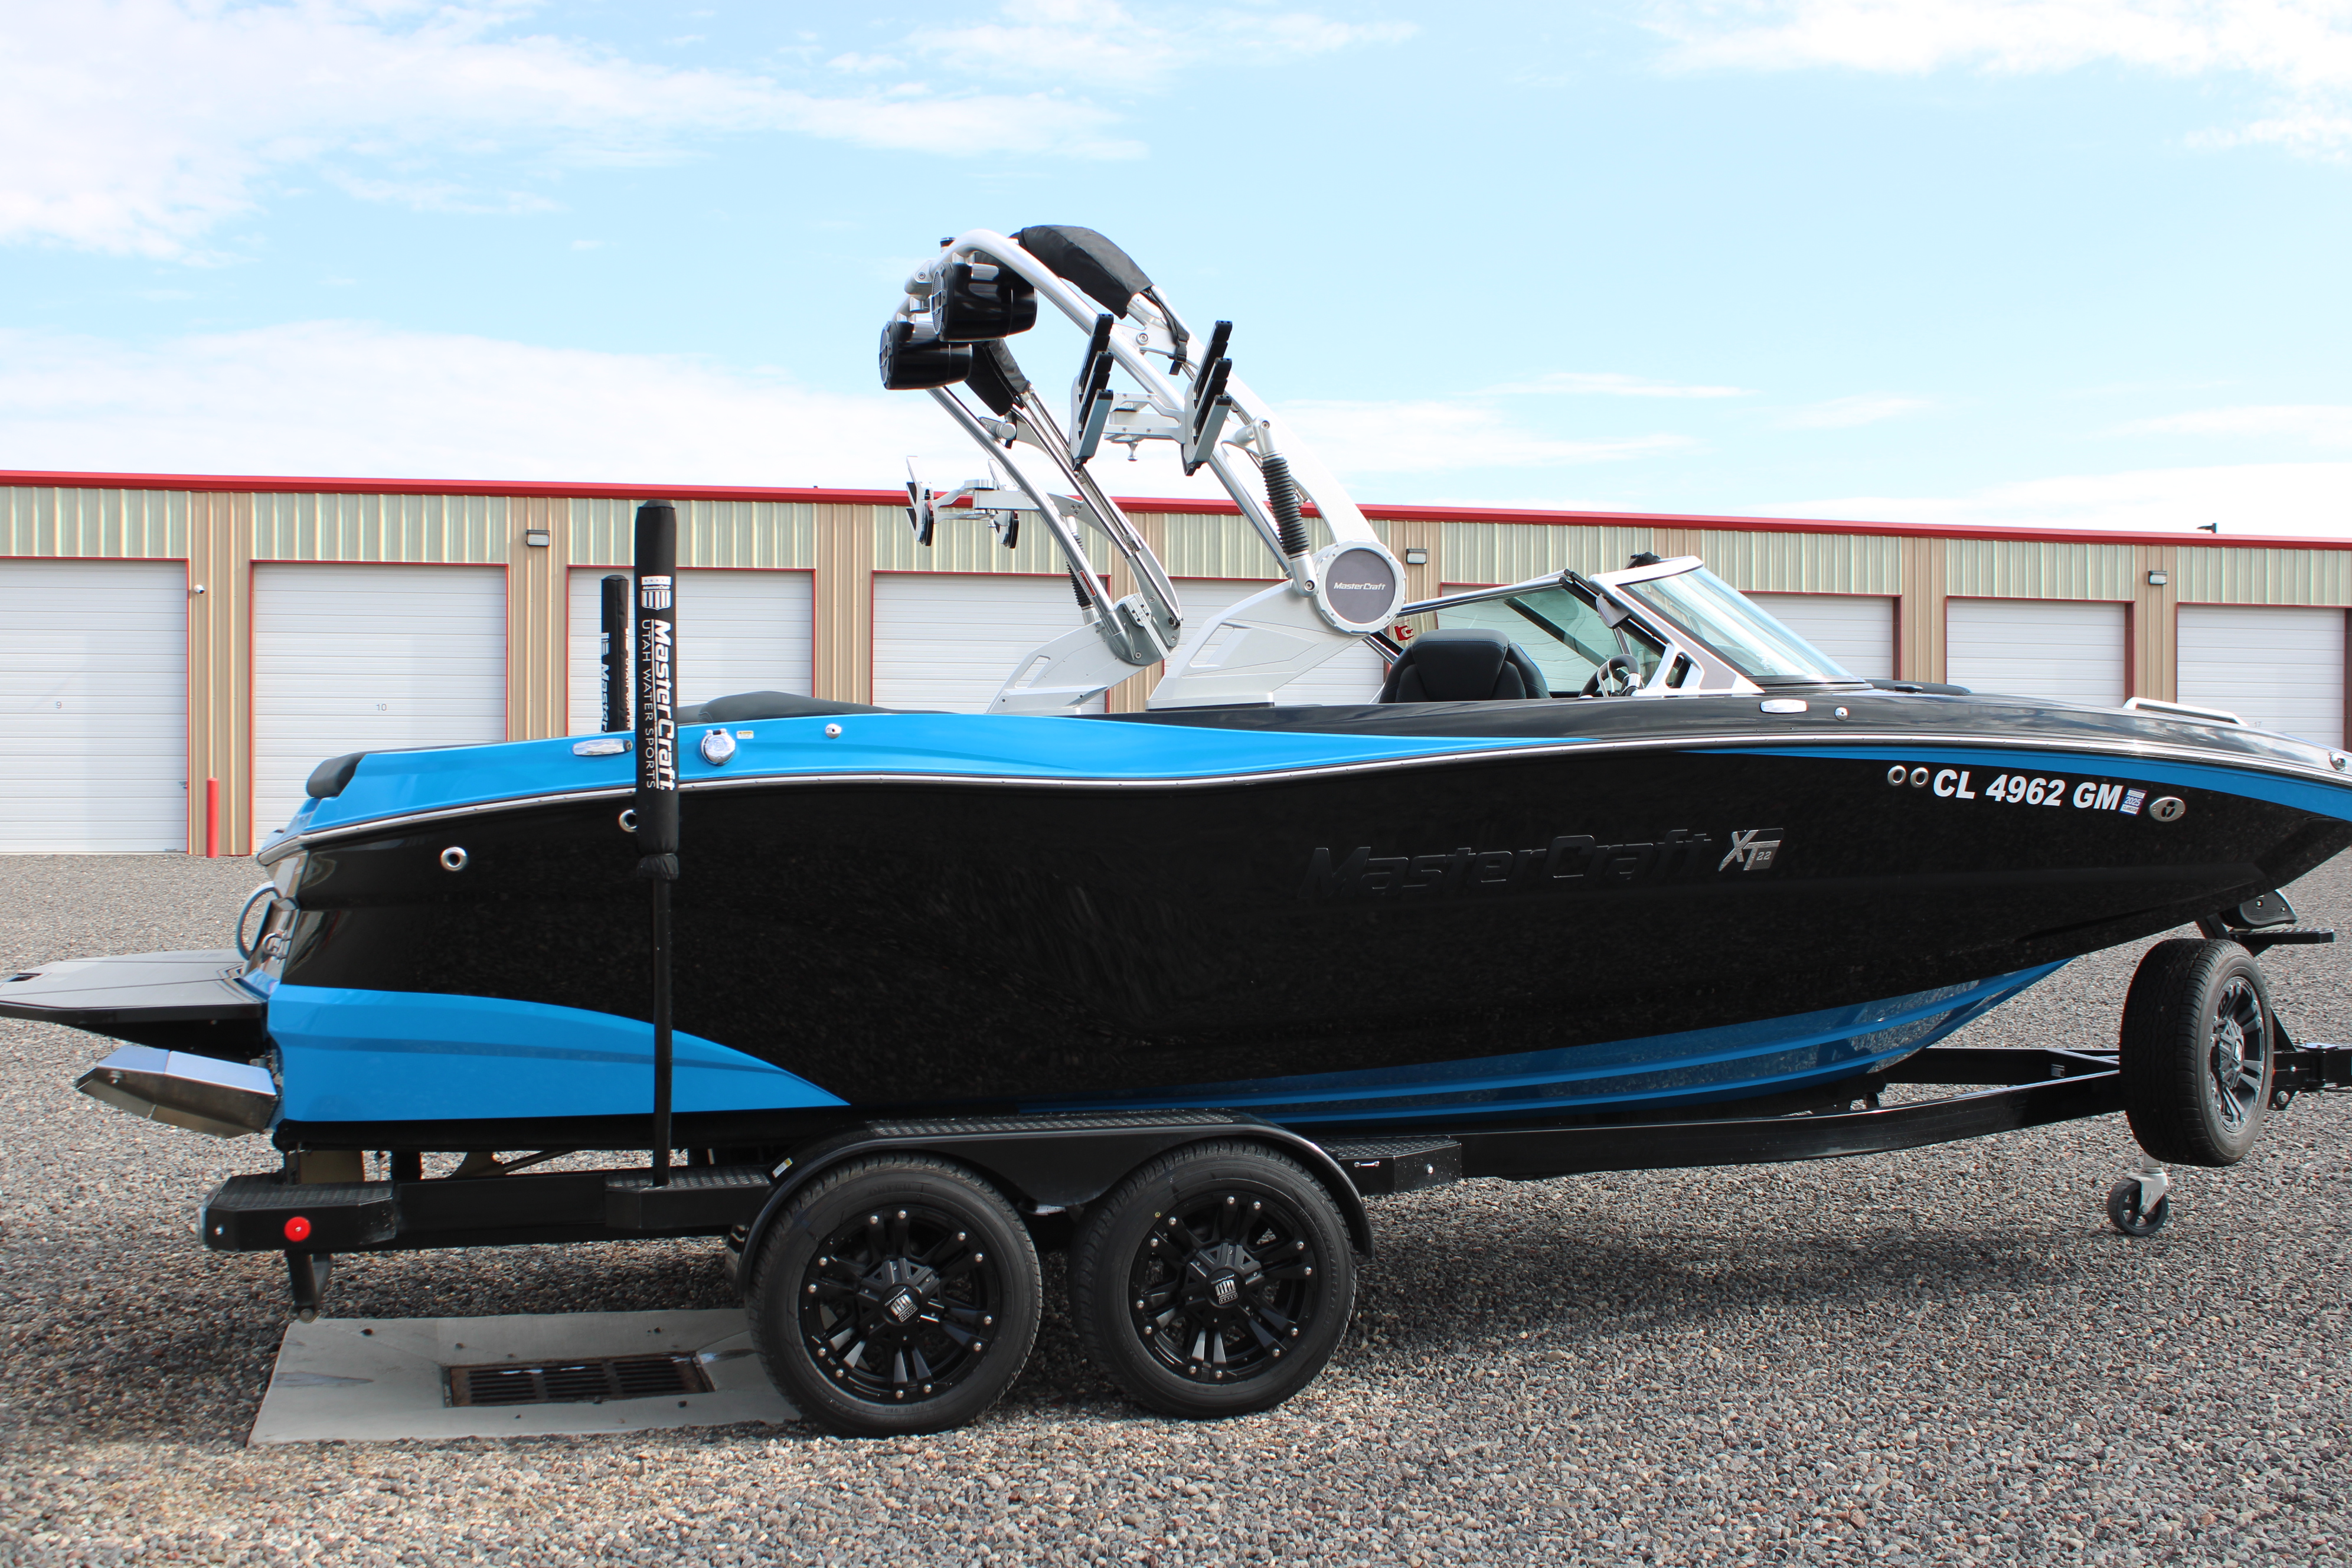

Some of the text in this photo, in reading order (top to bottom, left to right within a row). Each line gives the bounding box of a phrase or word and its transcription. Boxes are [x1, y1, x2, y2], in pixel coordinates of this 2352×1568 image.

[1334, 582, 1386, 590] MasterCraft
[601, 663, 609, 733] Master
[642, 619, 655, 789] UTAH WATER SPORTS
[654, 619, 675, 791] MasterCraft
[1933, 769, 2124, 810] CL 4962 GM
[2124, 796, 2142, 806] 2025
[1297, 829, 1711, 899] MasterCraft
[1756, 851, 1772, 861] 22
